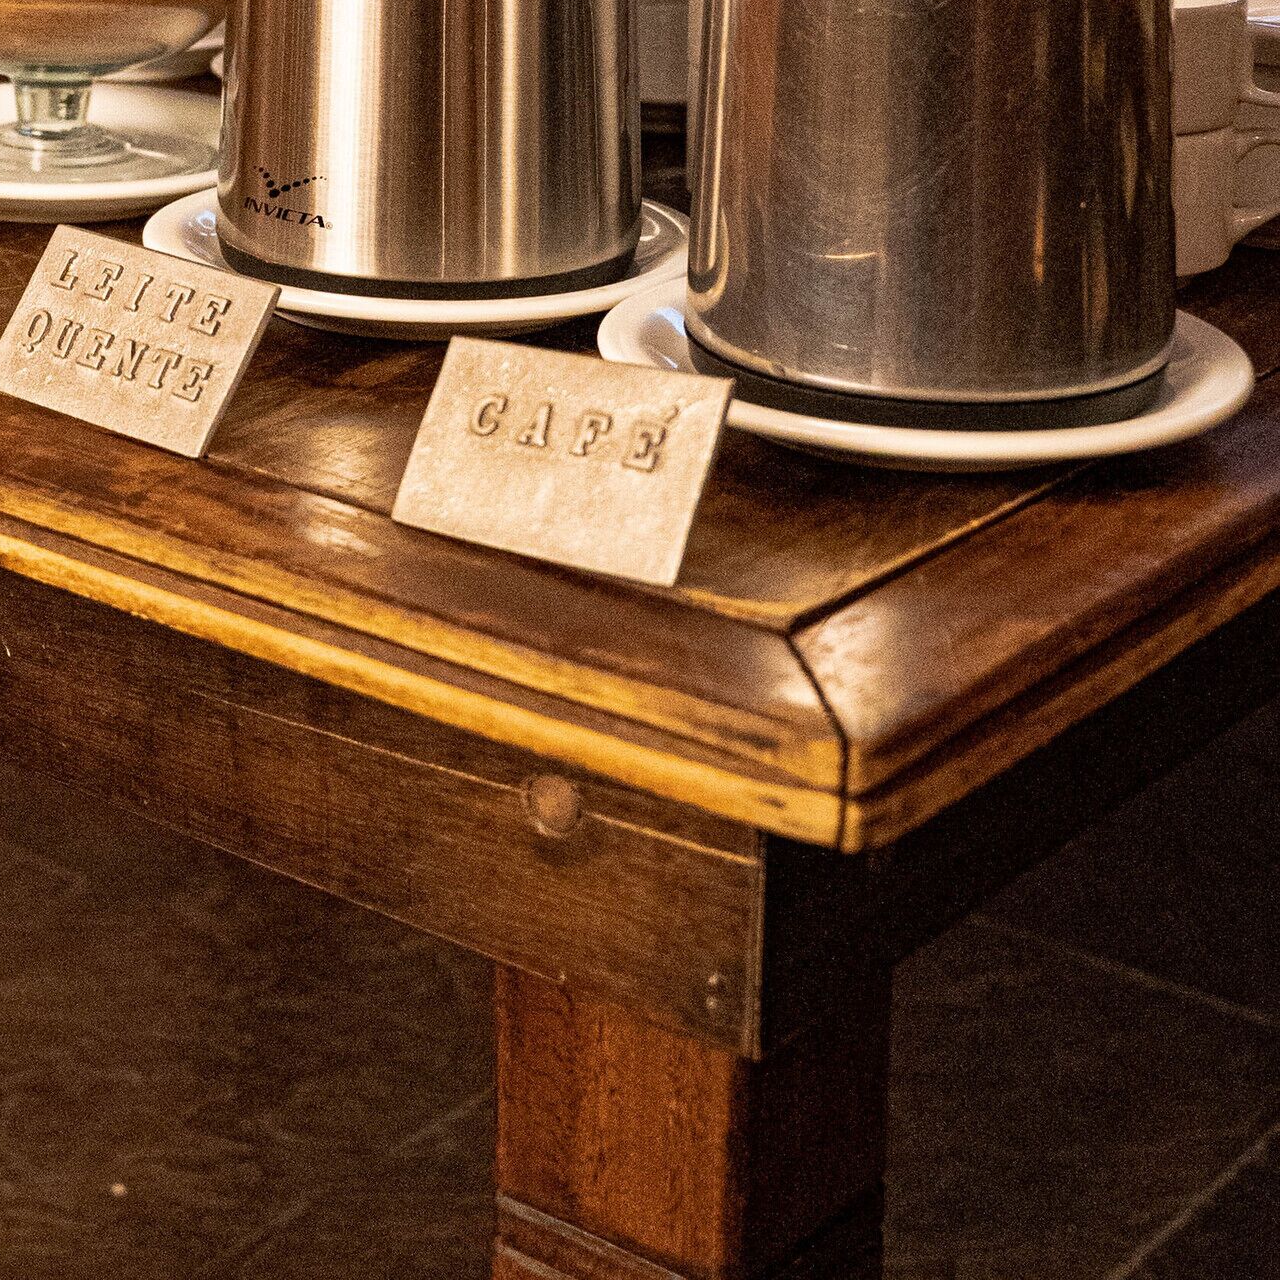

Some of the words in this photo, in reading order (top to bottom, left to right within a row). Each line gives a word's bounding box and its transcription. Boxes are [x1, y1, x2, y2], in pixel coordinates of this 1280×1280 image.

[243, 196, 326, 229] INVICTA
[50, 249, 233, 338] LEITE
[21, 308, 216, 403] QUENTE
[470, 392, 680, 473] CAFÉ
